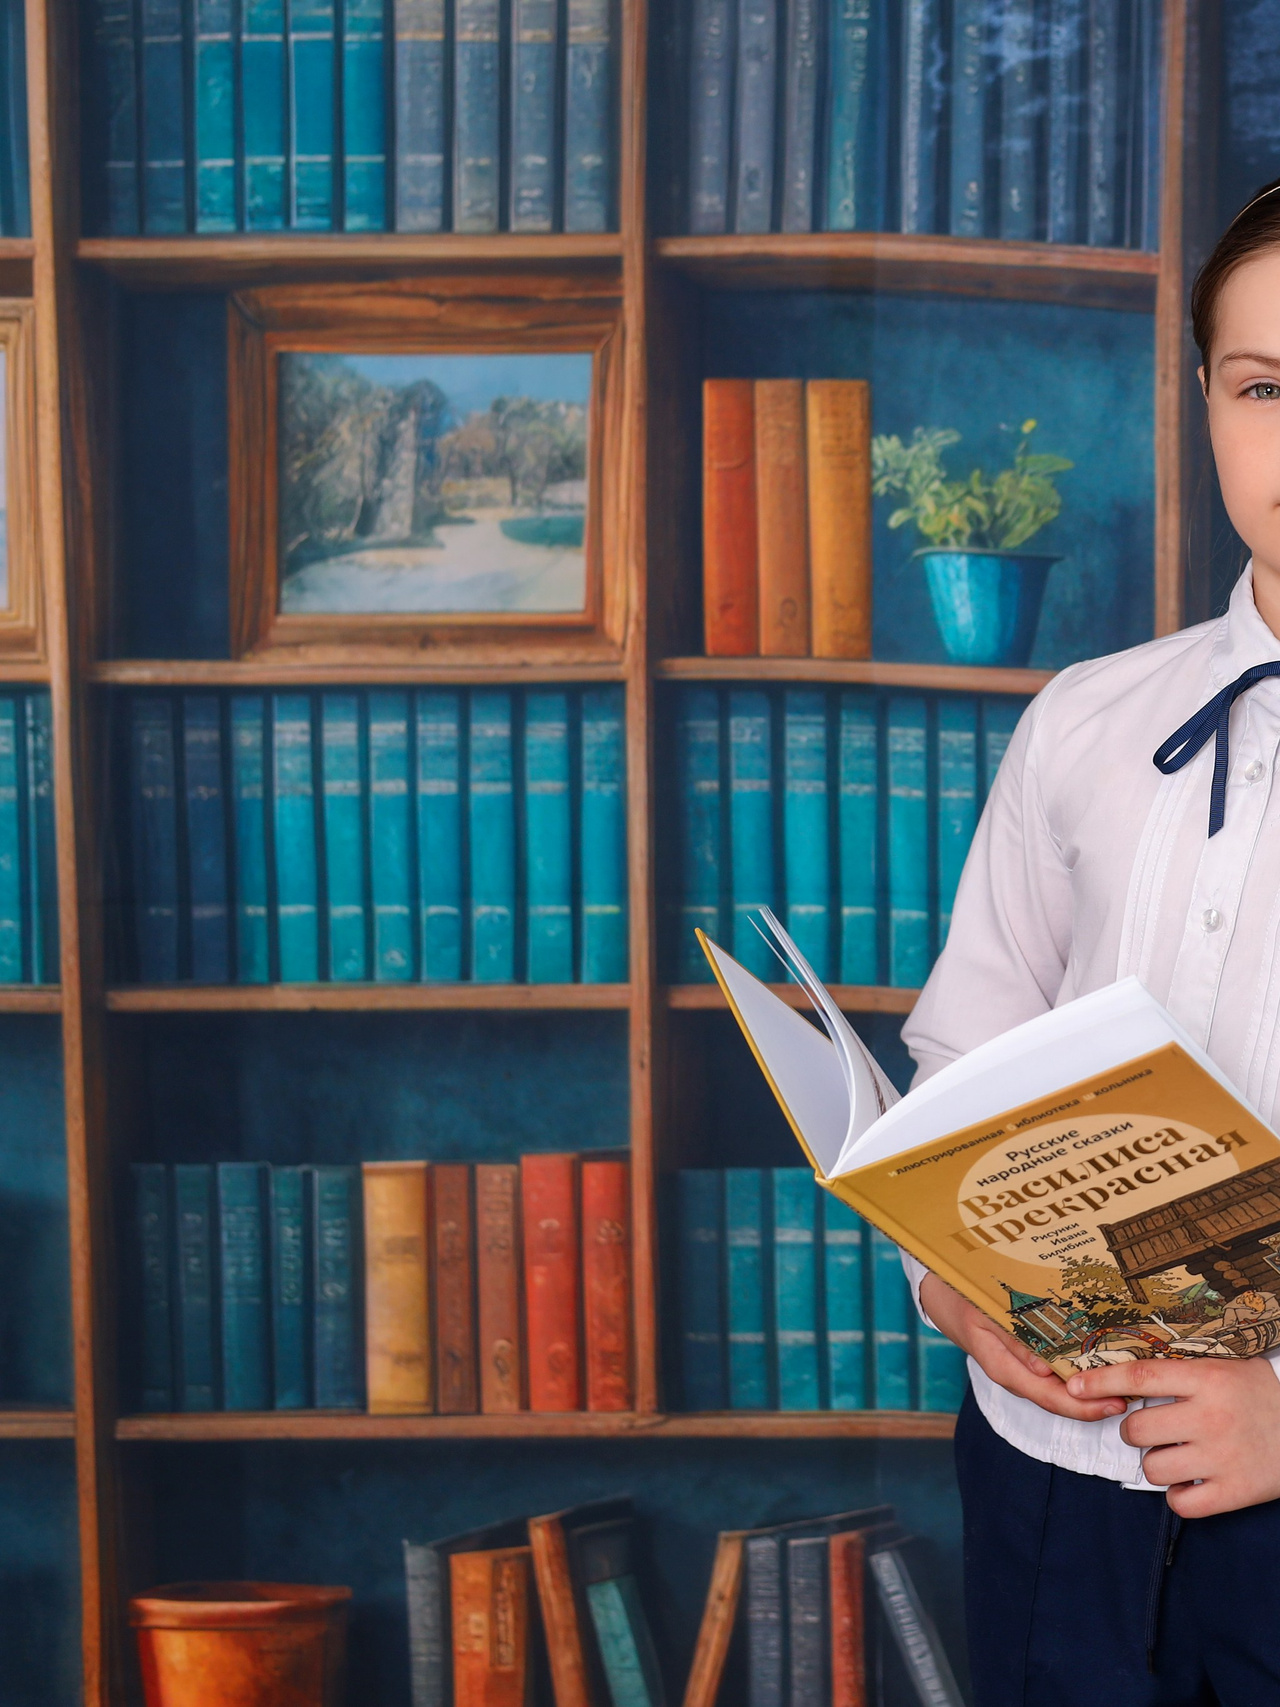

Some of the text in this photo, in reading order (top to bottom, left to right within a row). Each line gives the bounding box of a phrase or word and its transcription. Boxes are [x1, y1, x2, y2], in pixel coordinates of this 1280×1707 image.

[888, 1068, 1153, 1178] иллюстрированная библиотека школьника
[1005, 1129, 1080, 1162] Русские
[958, 1126, 1188, 1221] Василиса
[976, 1121, 1133, 1187] народные сказки
[947, 1129, 1251, 1253] Прекрасная
[1031, 1222, 1080, 1243] Рисунки
[1038, 1236, 1097, 1260] Билибина
[1050, 1229, 1088, 1246] Ивана
